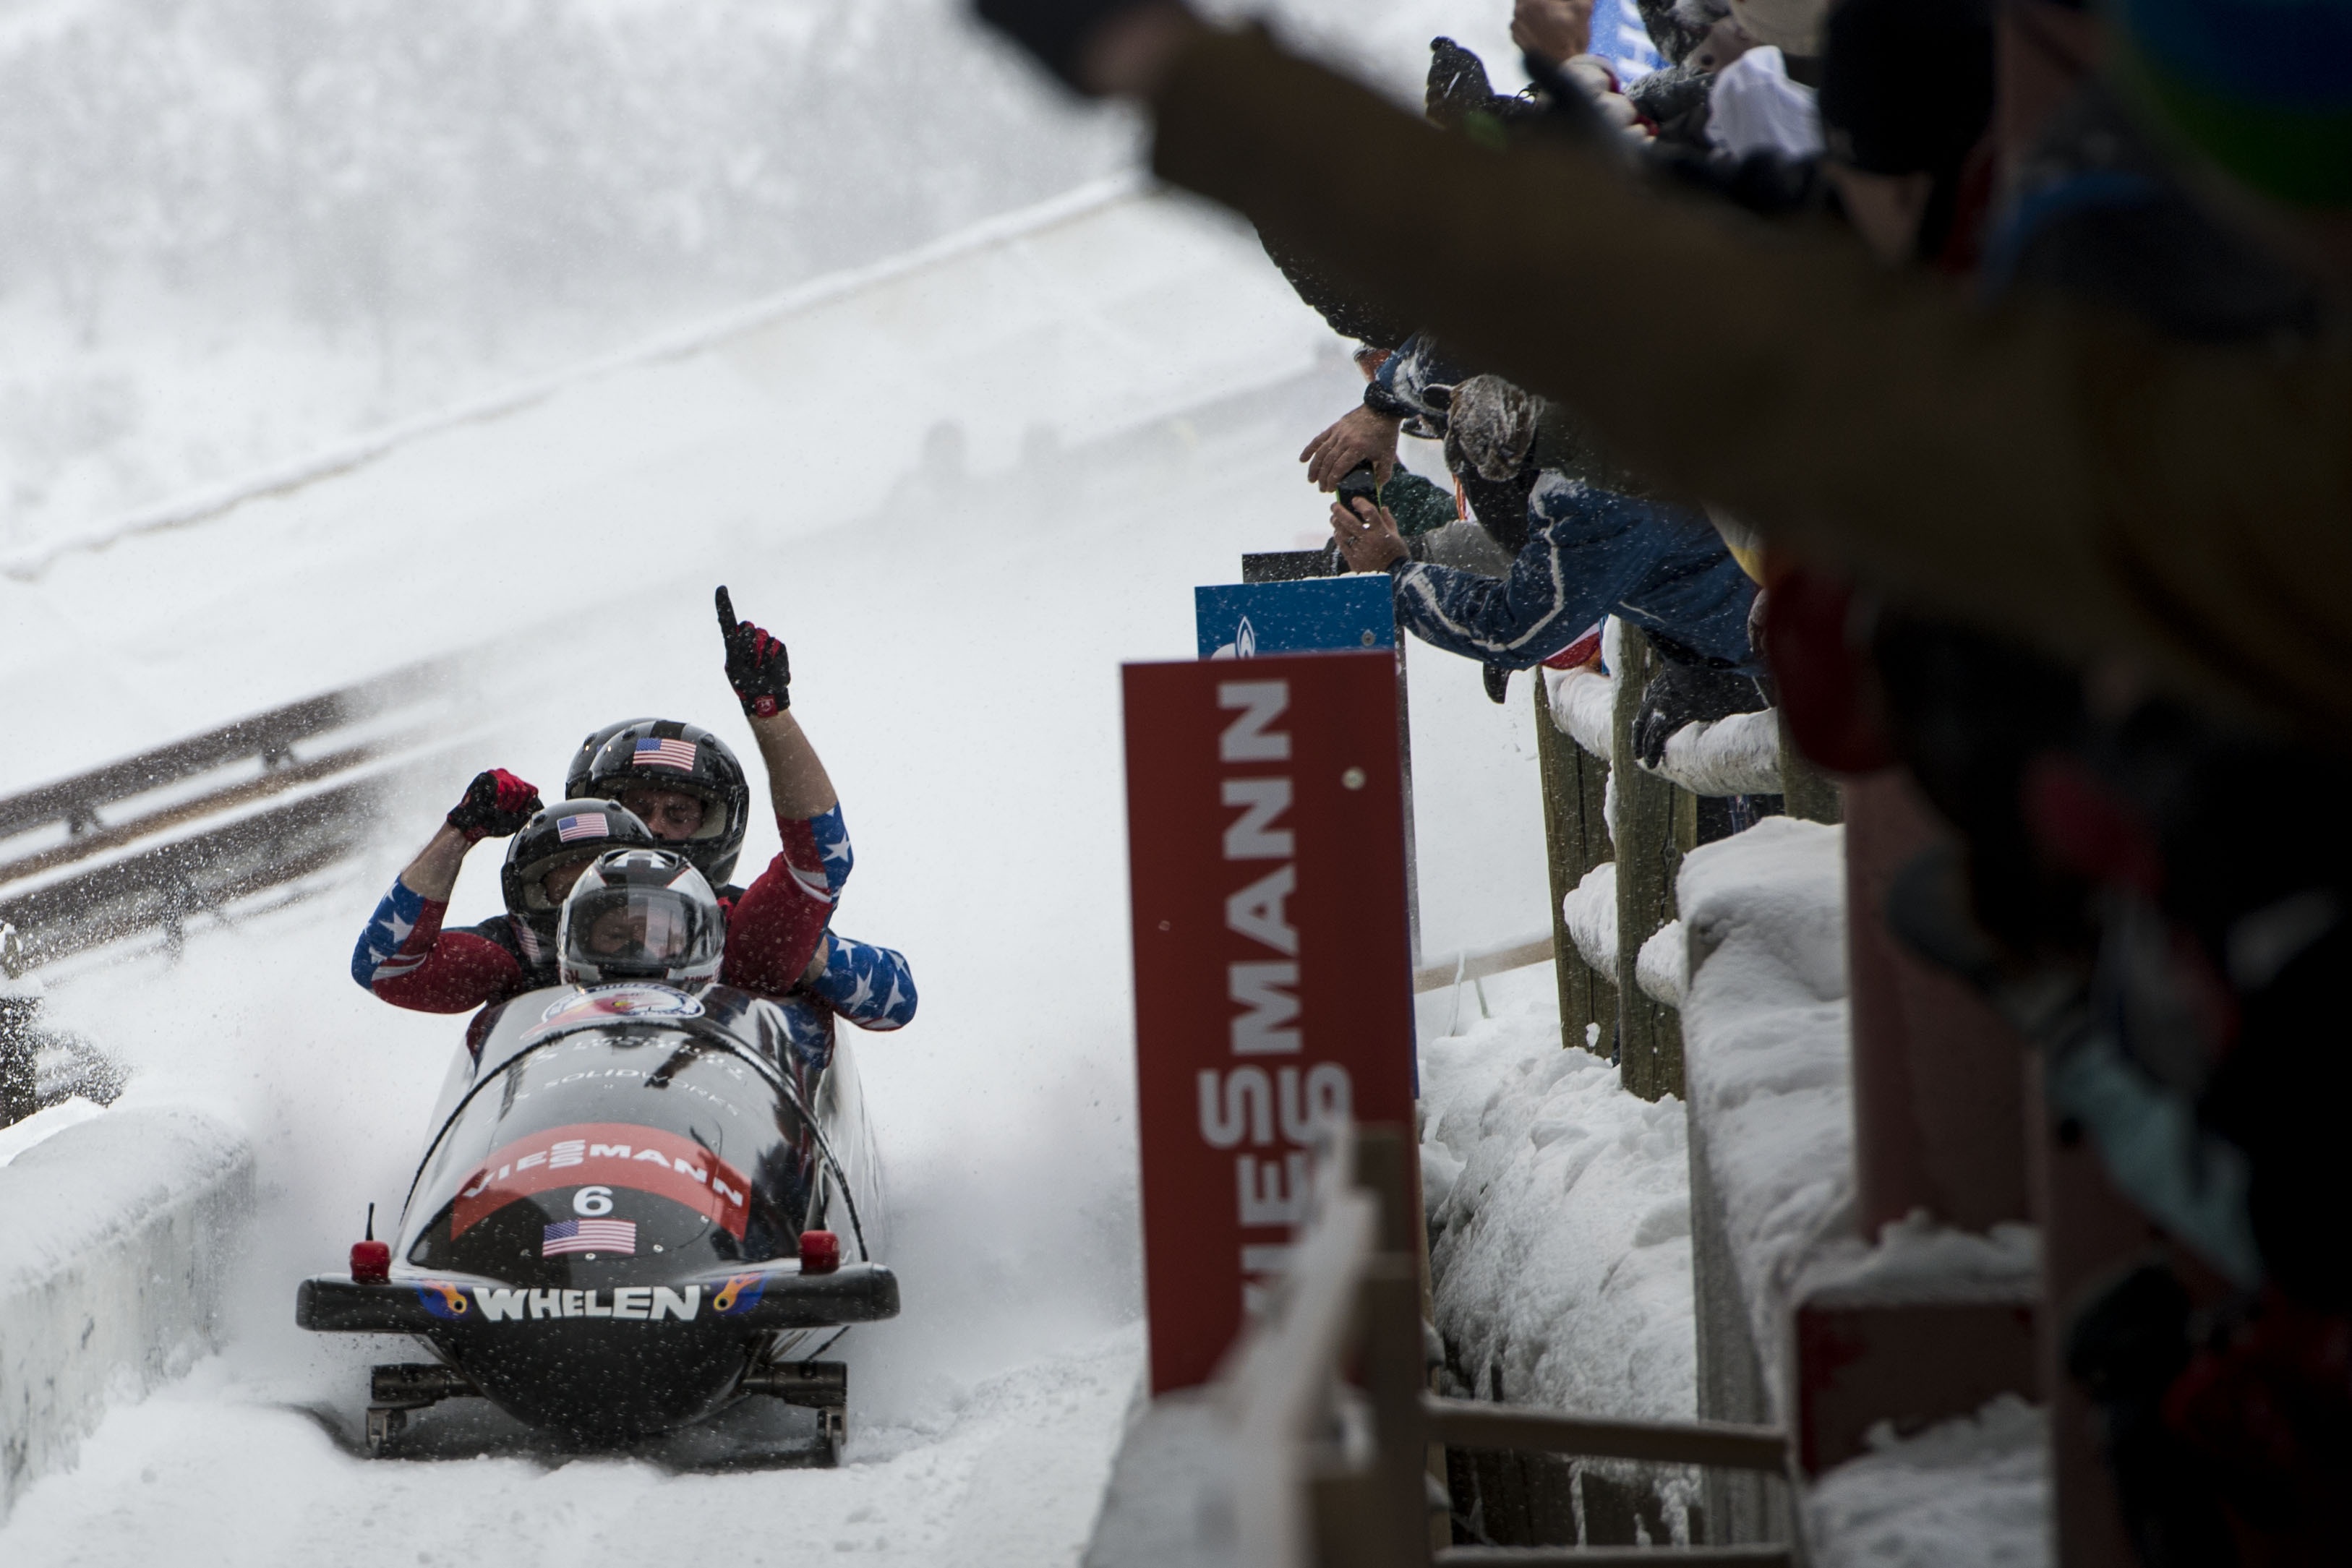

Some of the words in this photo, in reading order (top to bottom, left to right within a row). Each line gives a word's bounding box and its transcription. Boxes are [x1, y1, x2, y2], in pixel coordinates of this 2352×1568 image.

[1197, 678, 1352, 1314] IESSMANN
[544, 1068, 739, 1117] SOLIDWORKS
[462, 1139, 744, 1208] VIESSMANN
[572, 1185, 614, 1217] 6
[472, 1285, 701, 1322] WHELEN
